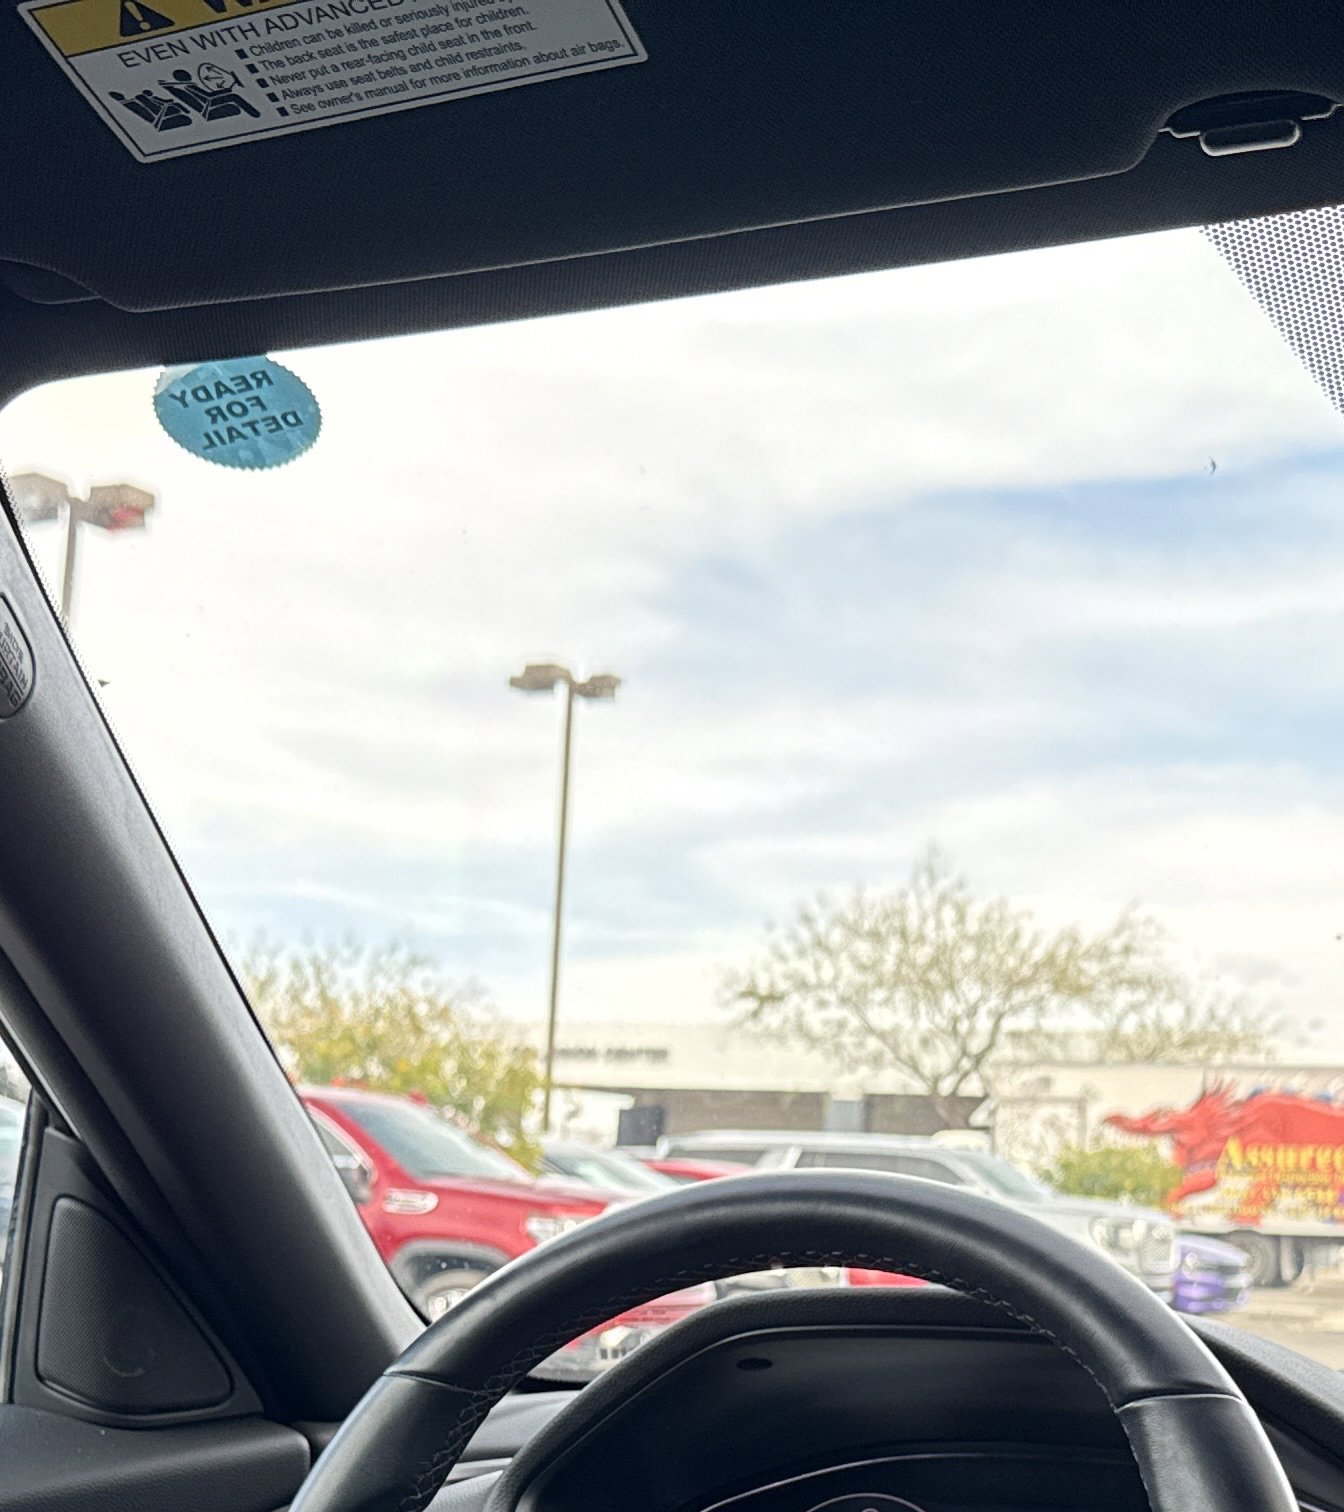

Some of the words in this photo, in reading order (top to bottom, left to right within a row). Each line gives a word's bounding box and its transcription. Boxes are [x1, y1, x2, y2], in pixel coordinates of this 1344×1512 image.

[117, 40, 190, 68] EVEN
[190, 22, 260, 51] WITH
[249, 37, 302, 56] Children
[302, 32, 326, 45] can
[326, 27, 344, 39] be
[344, 19, 378, 35] killed
[379, 16, 392, 28] or
[395, 4, 451, 25] seriously
[258, 58, 285, 72] The
[285, 50, 317, 66] back
[317, 44, 346, 59] seat
[346, 39, 358, 53] is
[358, 36, 380, 49] the
[381, 28, 419, 46] safest
[420, 20, 454, 39] place
[456, 16, 473, 29] for
[271, 69, 309, 86] Never
[309, 66, 330, 81] put
[341, 47, 406, 72] rear-facing
[407, 40, 437, 57] child
[438, 35, 467, 50] seat
[467, 31, 480, 43] in
[480, 28, 502, 41] the
[282, 80, 324, 101] Always
[327, 78, 348, 92] use
[349, 71, 376, 87] seat
[377, 64, 406, 81] belts
[406, 58, 432, 74] and
[434, 51, 464, 68] child
[290, 101, 316, 116] See
[317, 91, 363, 109] owner's
[364, 83, 409, 101] manual
[410, 77, 428, 91] for
[430, 71, 461, 88] more
[462, 55, 531, 80] information
[533, 47, 568, 67] about
[569, 42, 588, 57] air
